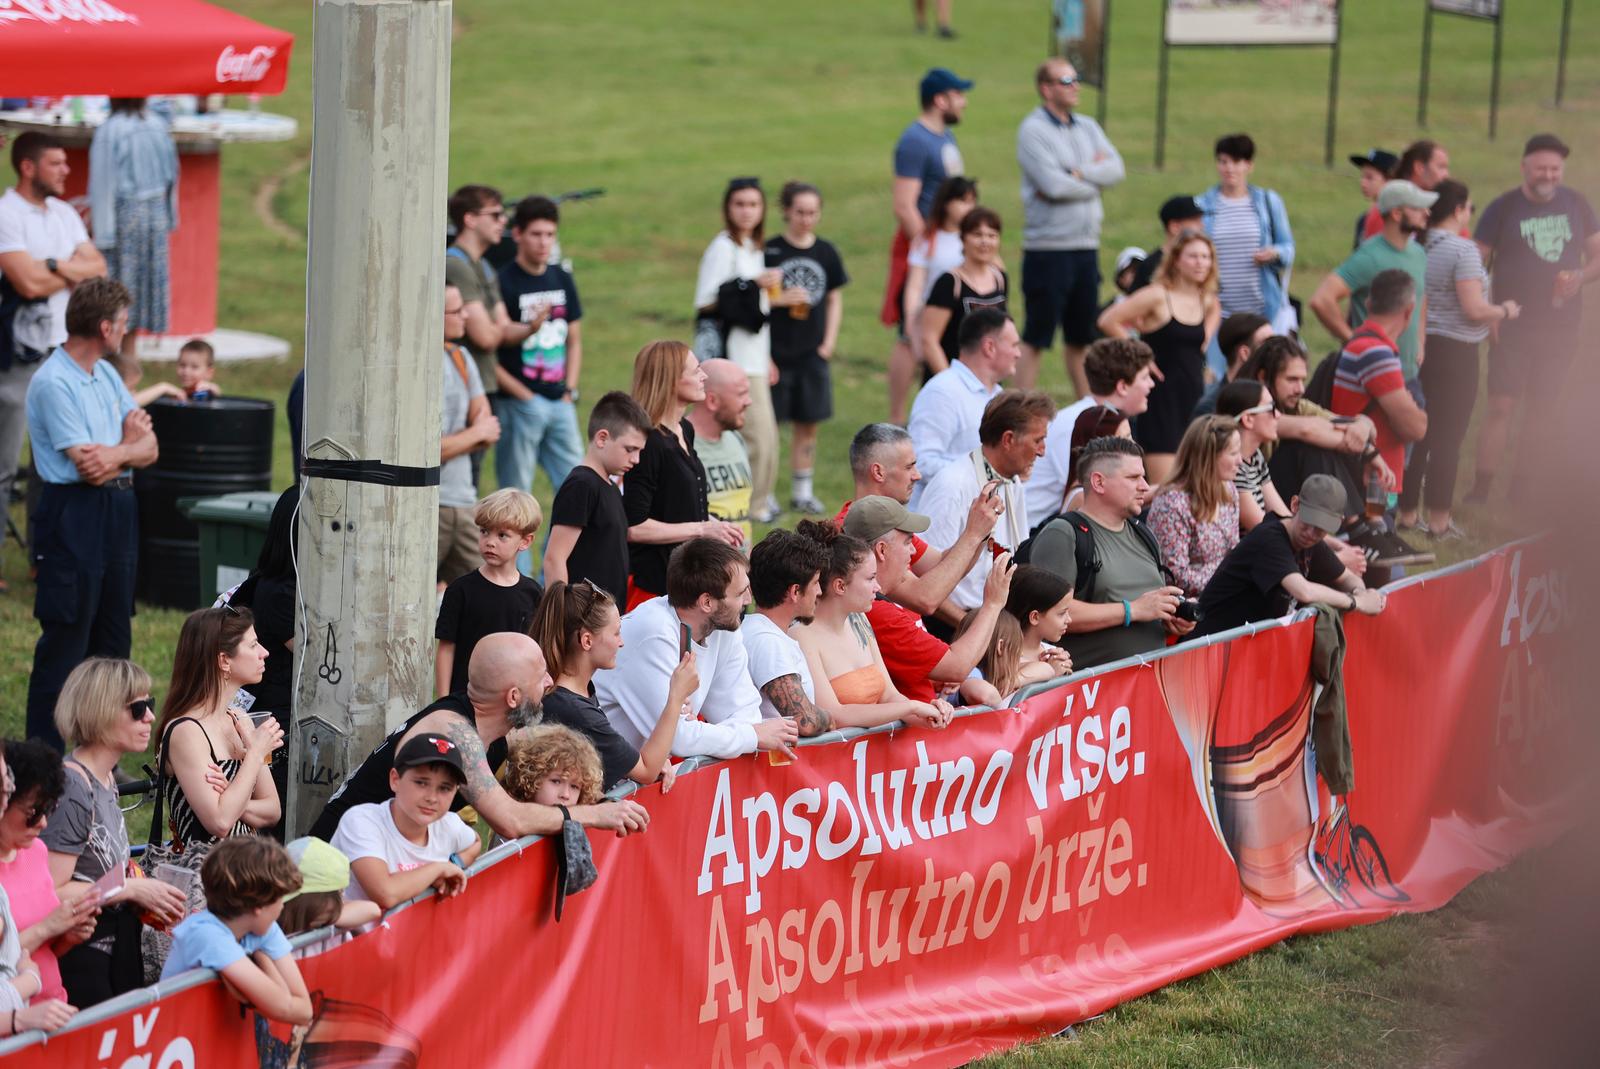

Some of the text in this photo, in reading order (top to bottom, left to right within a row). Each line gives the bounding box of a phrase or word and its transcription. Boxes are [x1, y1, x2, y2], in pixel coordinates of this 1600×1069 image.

[697, 680, 1146, 914] Apsolutno više.
[698, 792, 1148, 1040] Apsolutno brže.
